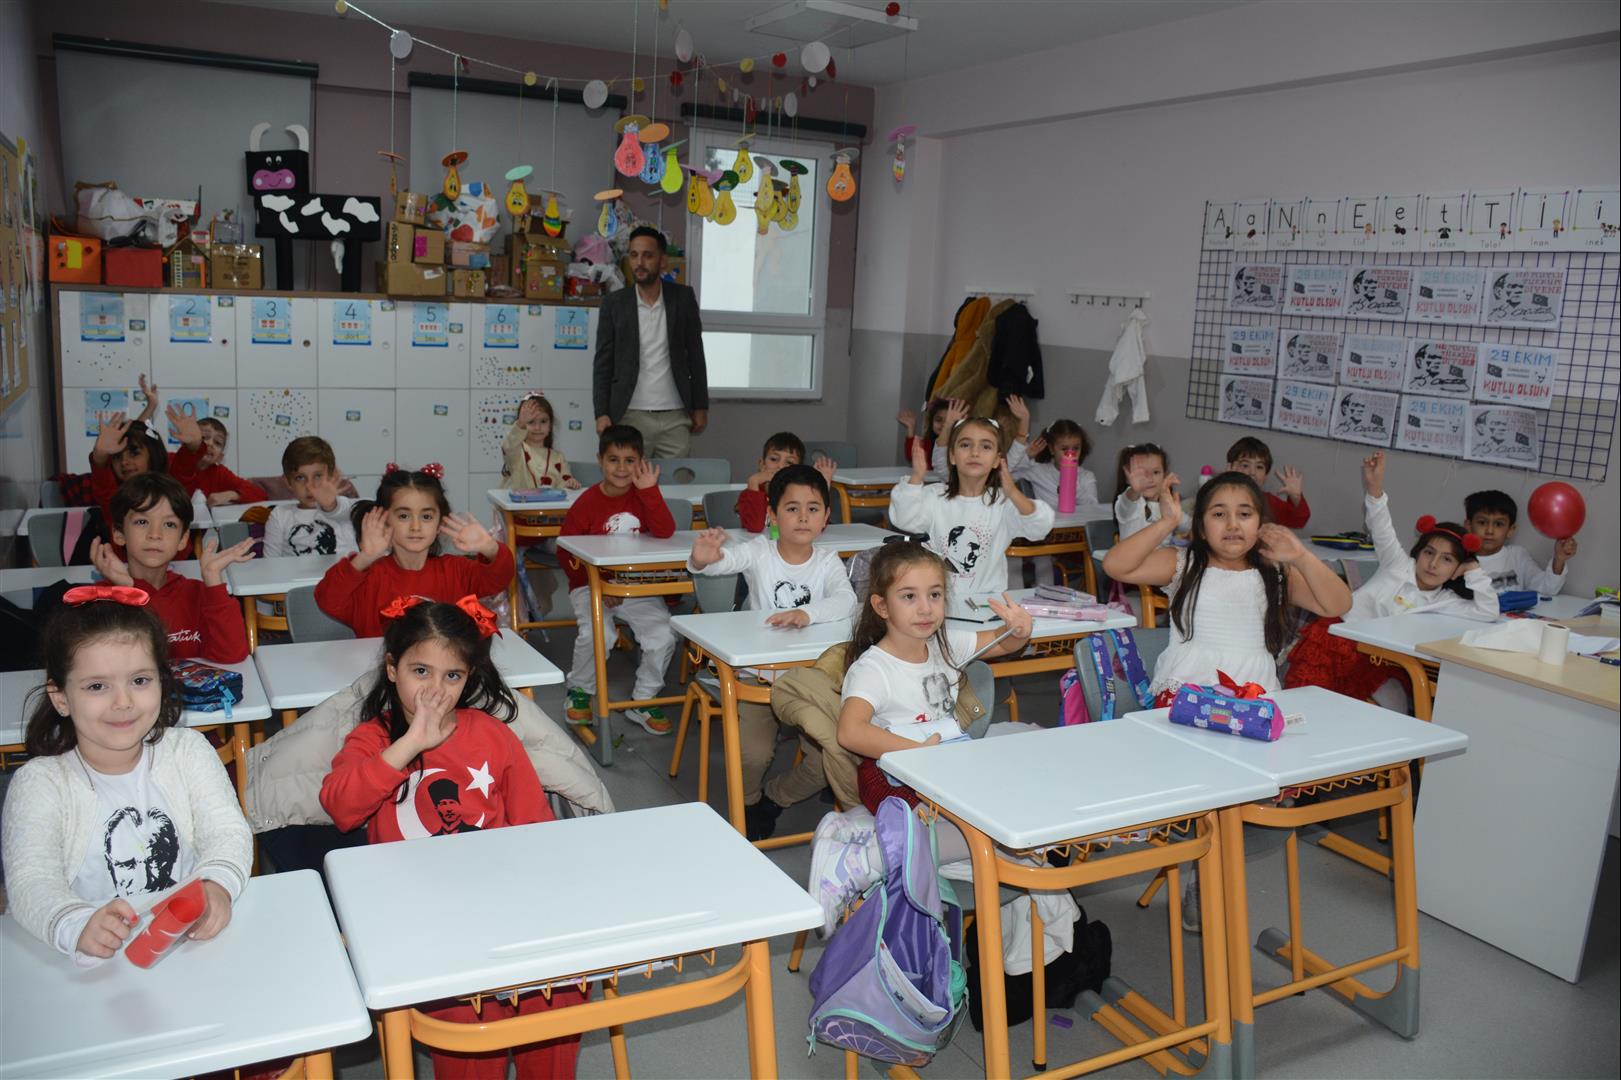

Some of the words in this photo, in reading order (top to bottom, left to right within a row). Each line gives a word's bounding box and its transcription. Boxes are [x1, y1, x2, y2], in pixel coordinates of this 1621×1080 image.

[1214, 208, 1225, 228] A
[1246, 213, 1256, 226] a
[1278, 206, 1294, 229] N
[1317, 212, 1328, 225] n
[1353, 203, 1367, 229] E
[1395, 206, 1405, 221] e
[1440, 203, 1449, 224] t
[1484, 202, 1500, 229] T
[185, 299, 198, 315] 2
[265, 300, 277, 318] 3
[344, 303, 357, 319] 4
[426, 306, 437, 322] 5
[497, 308, 506, 323] 6
[568, 311, 577, 323] 7
[1490, 350, 1509, 362] 29
[1483, 381, 1514, 394] KUTLU
[1517, 382, 1550, 398] OLSUN
[100, 391, 112, 409] 9
[1410, 400, 1426, 413] 29
